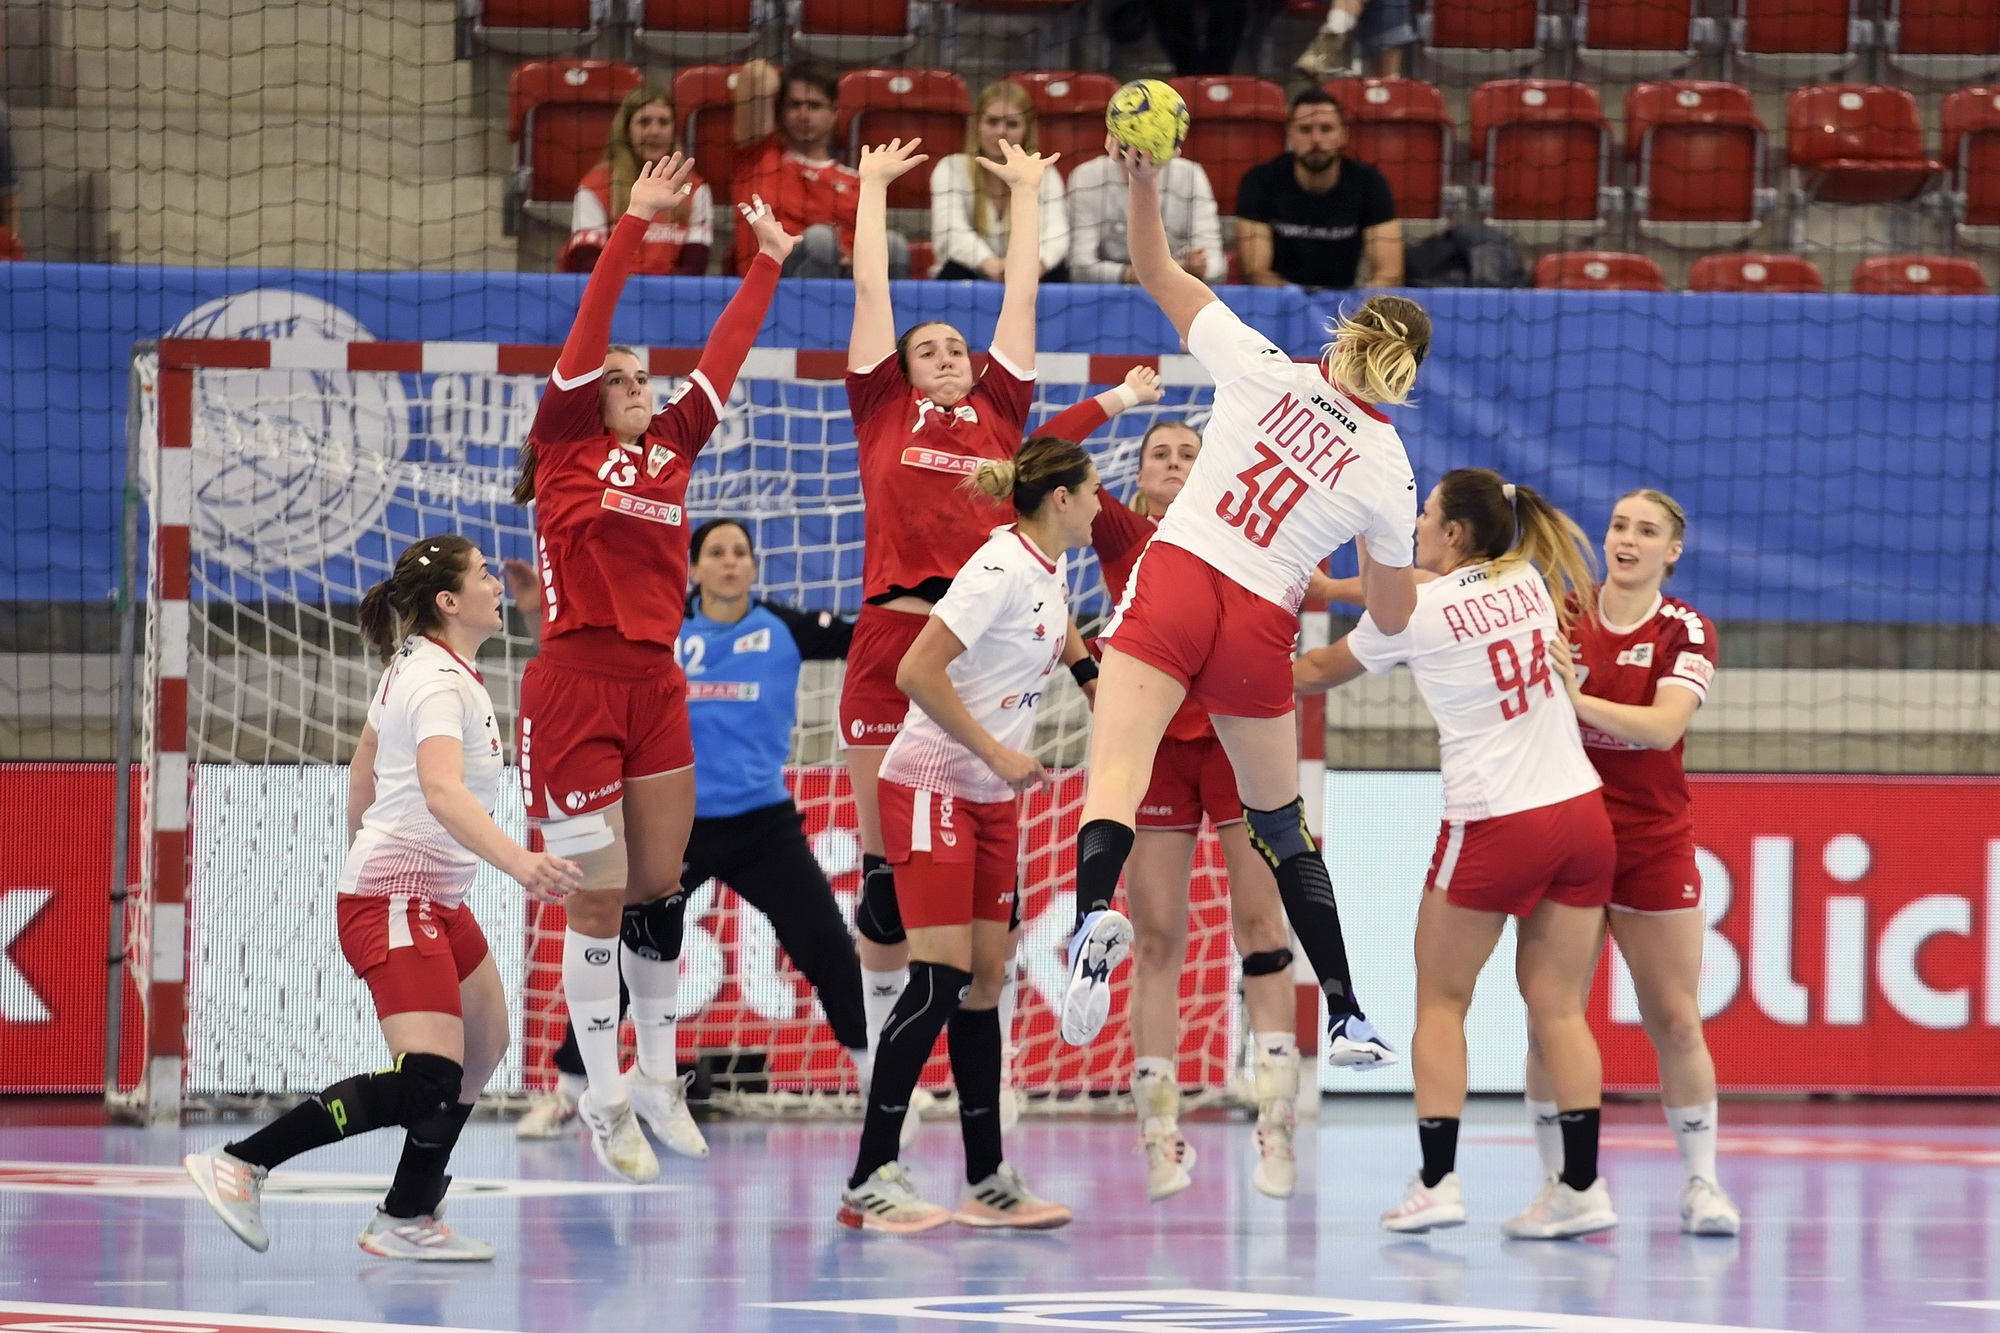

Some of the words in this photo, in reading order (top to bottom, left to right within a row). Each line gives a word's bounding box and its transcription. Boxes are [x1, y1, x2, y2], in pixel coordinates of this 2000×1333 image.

[918, 451, 978, 473] SPAR
[1257, 391, 1361, 491] NOSEK
[618, 496, 670, 520] SPAR
[1215, 440, 1310, 549] 39
[1487, 628, 1555, 721] 94
[1608, 833, 2000, 1030] Blic
